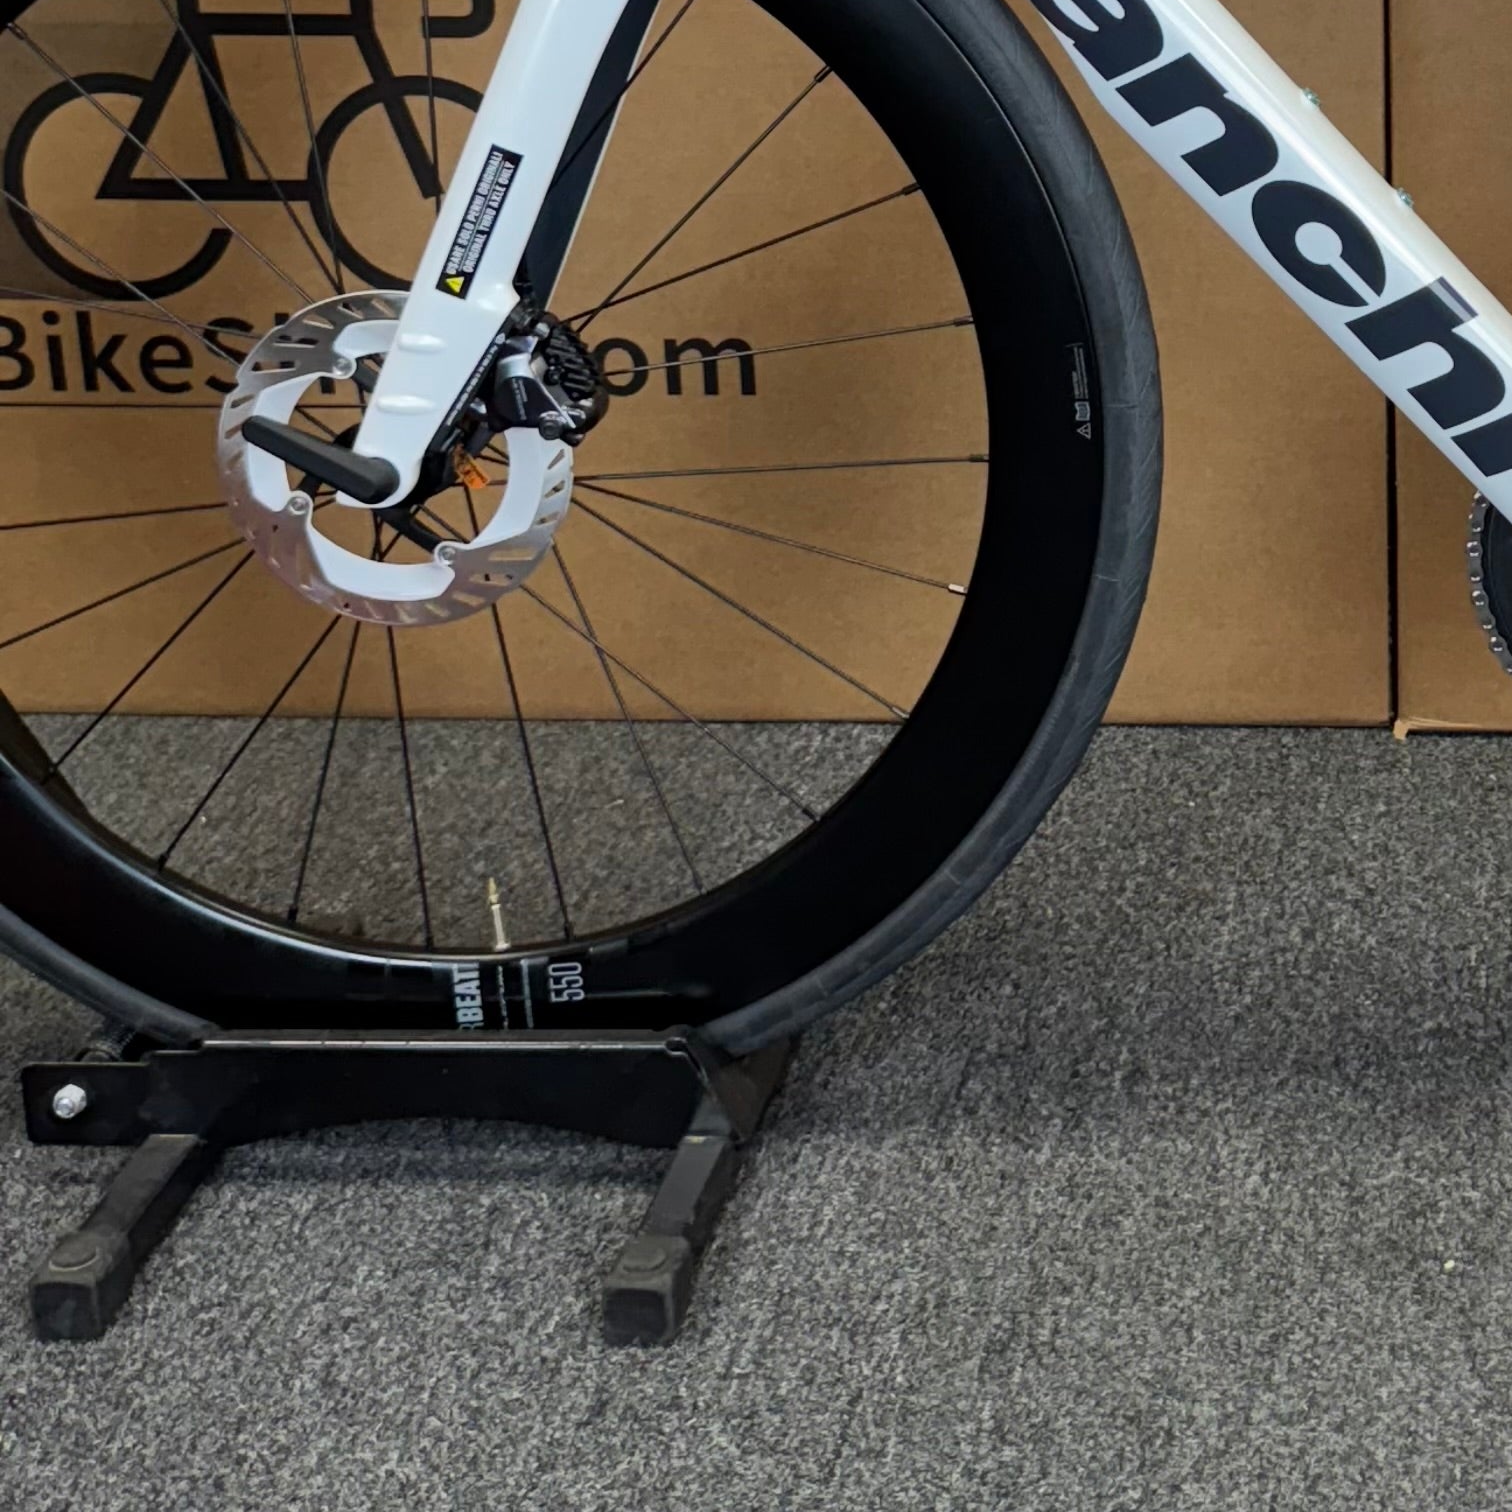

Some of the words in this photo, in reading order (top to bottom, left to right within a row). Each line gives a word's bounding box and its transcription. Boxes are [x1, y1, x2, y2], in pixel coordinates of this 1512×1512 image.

[497, 160, 515, 185] ONLY
[489, 185, 507, 208] AXLE
[457, 221, 475, 246] SOLO
[548, 961, 585, 1003] 550
